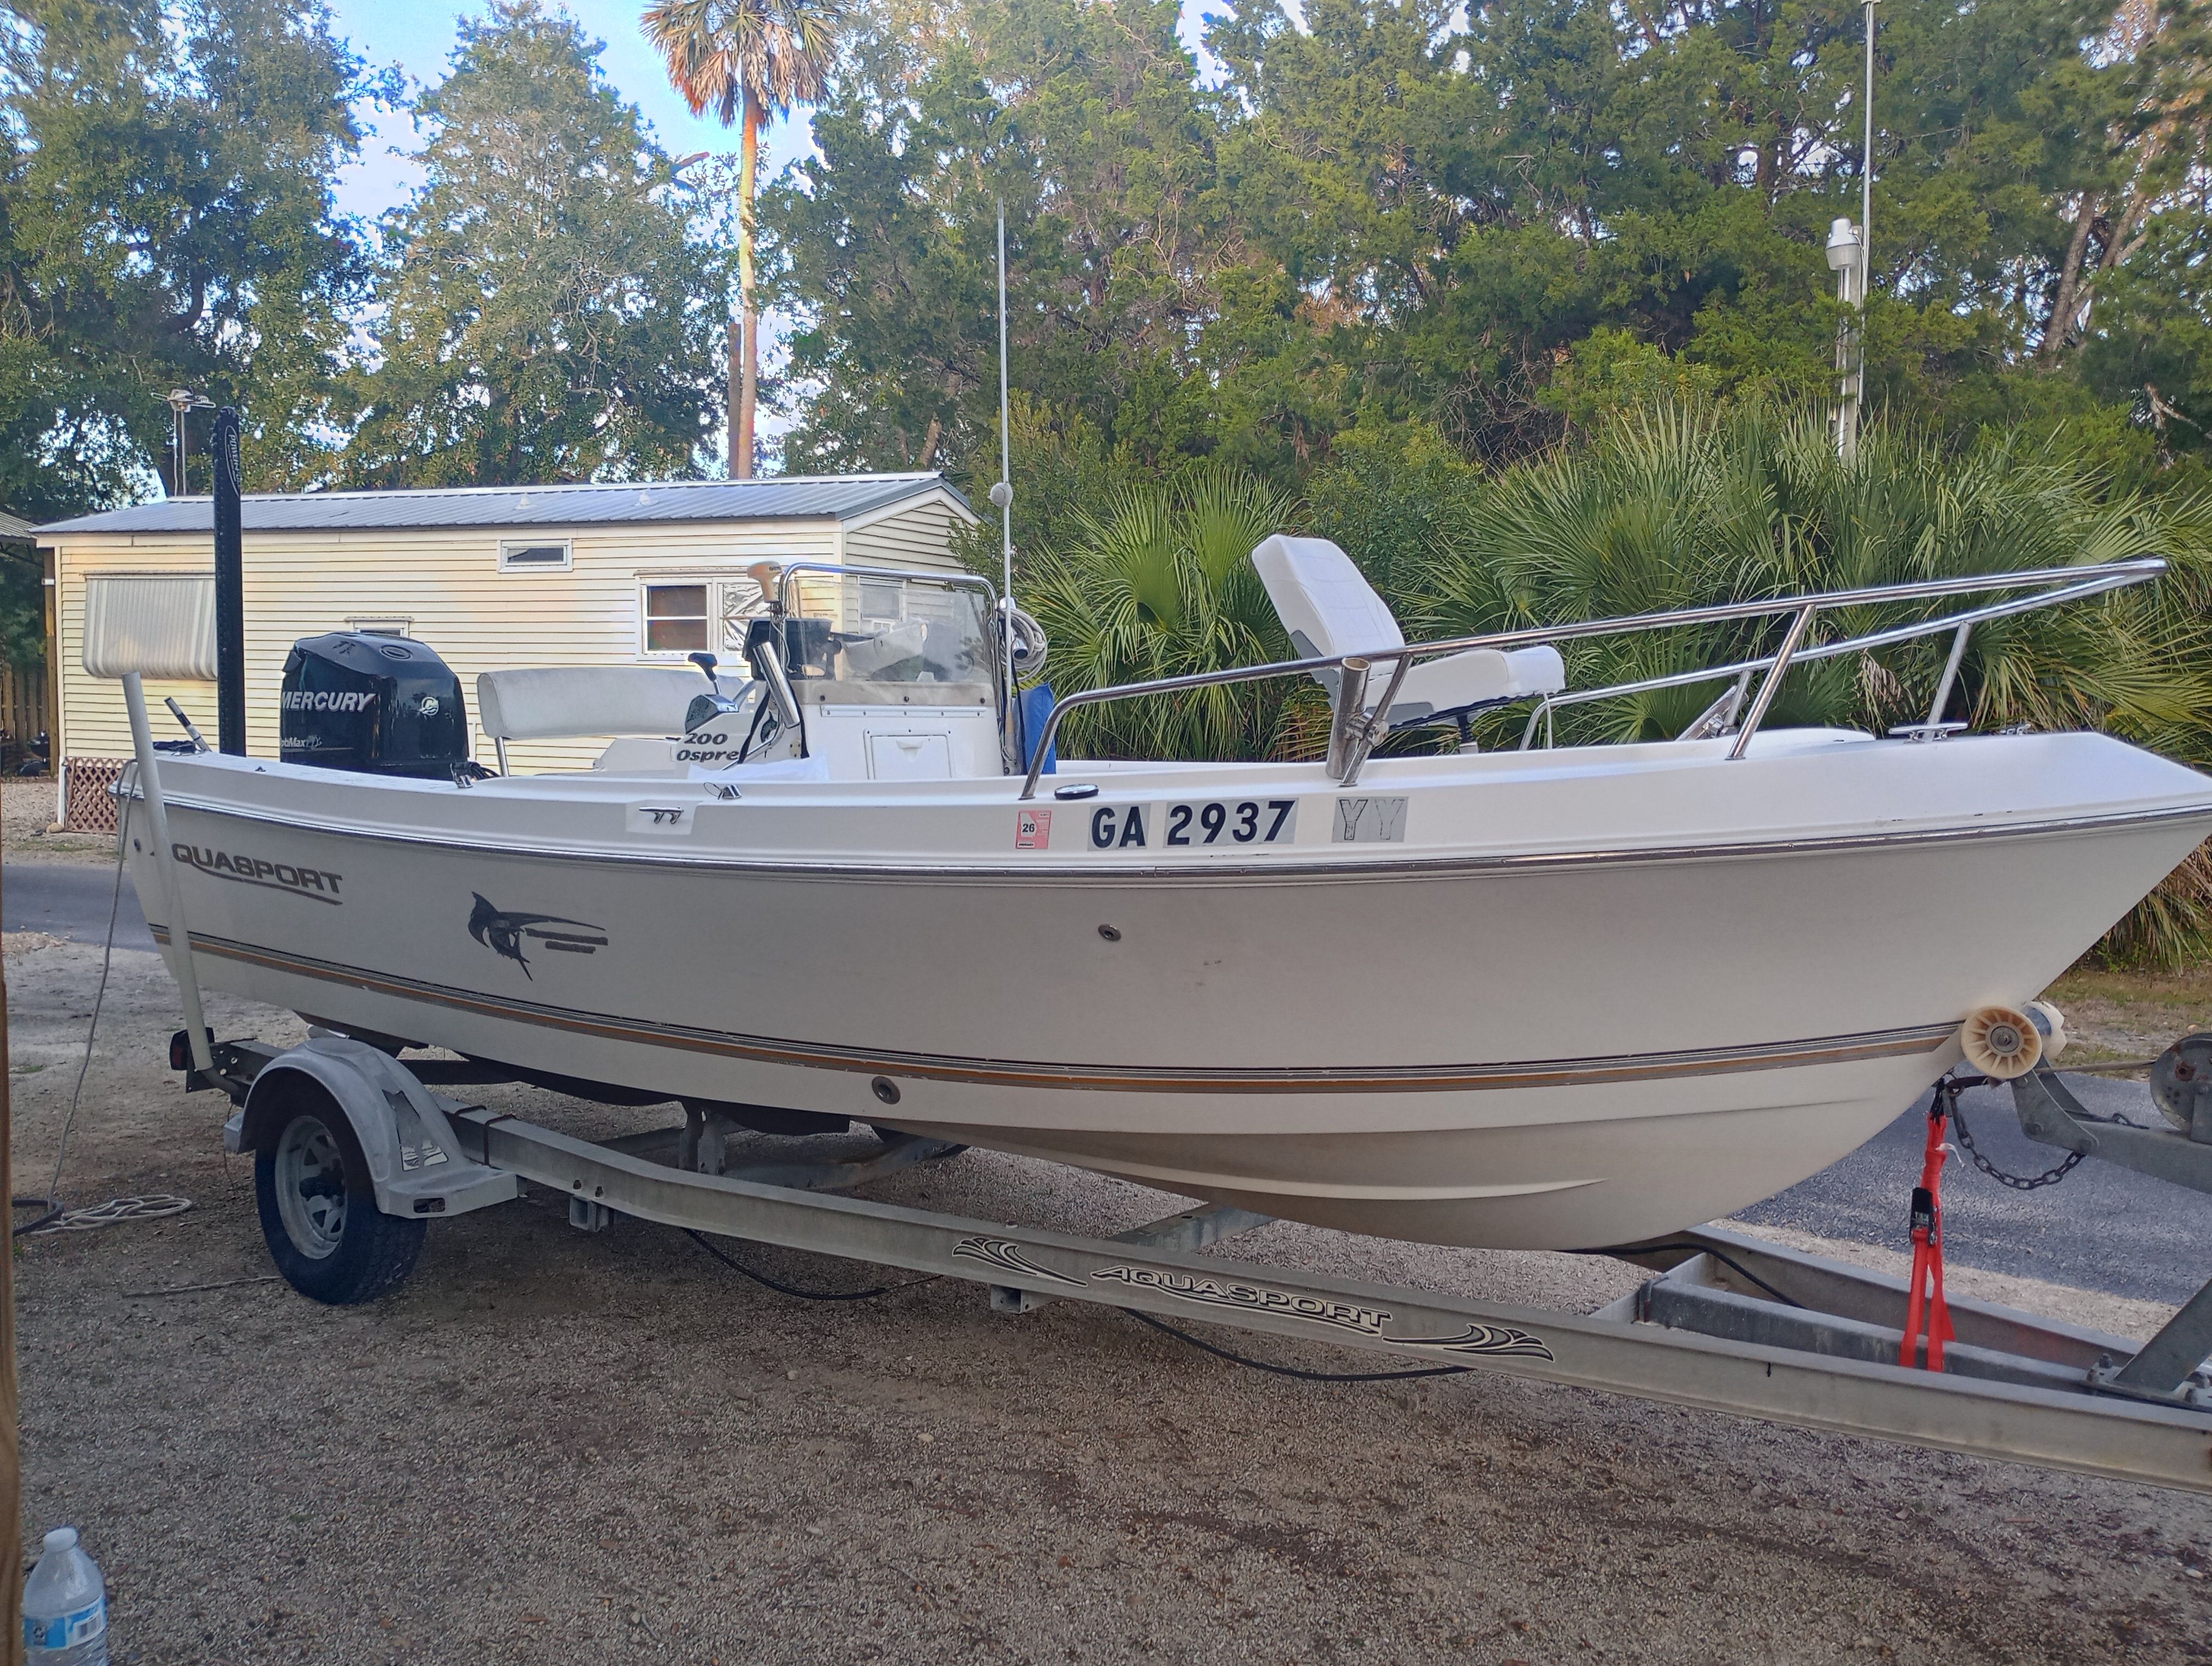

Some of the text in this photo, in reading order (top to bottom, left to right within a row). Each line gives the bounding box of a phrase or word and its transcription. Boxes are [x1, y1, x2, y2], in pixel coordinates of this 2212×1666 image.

[281, 690, 376, 713] MERCURY
[684, 733, 728, 745] 200
[677, 749, 740, 762] Ospre
[1022, 823, 1035, 832] 26
[1091, 806, 1146, 848] GA
[1167, 800, 1295, 845] 2937
[150, 843, 343, 894] QUASPORT
[1090, 1265, 1392, 1326] AQUASPORT
